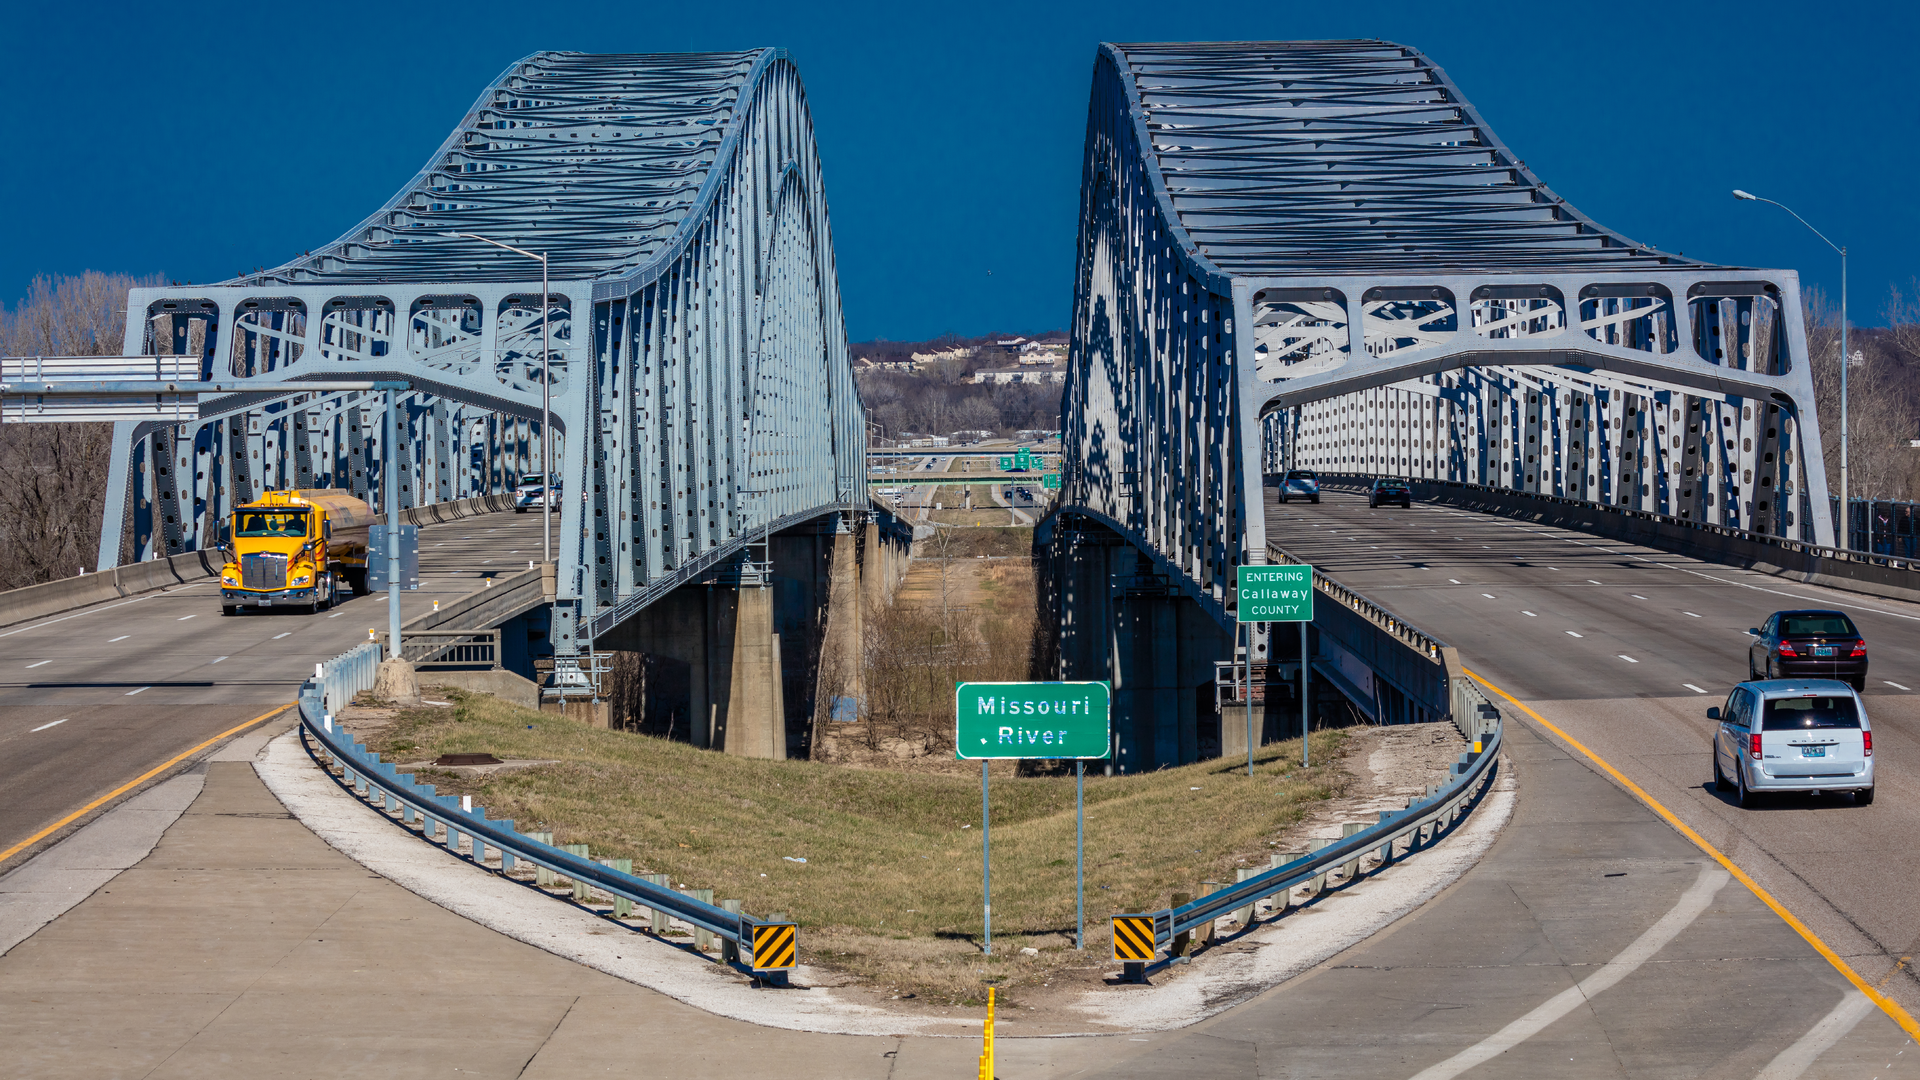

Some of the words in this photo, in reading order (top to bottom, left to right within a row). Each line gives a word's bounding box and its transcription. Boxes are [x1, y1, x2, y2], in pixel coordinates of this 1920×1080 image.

[1246, 572, 1303, 582] ENTERING
[1241, 588, 1308, 601] Callaway
[1251, 604, 1299, 615] COUNTY
[978, 696, 1089, 715] Missouri
[998, 726, 1068, 745] River
